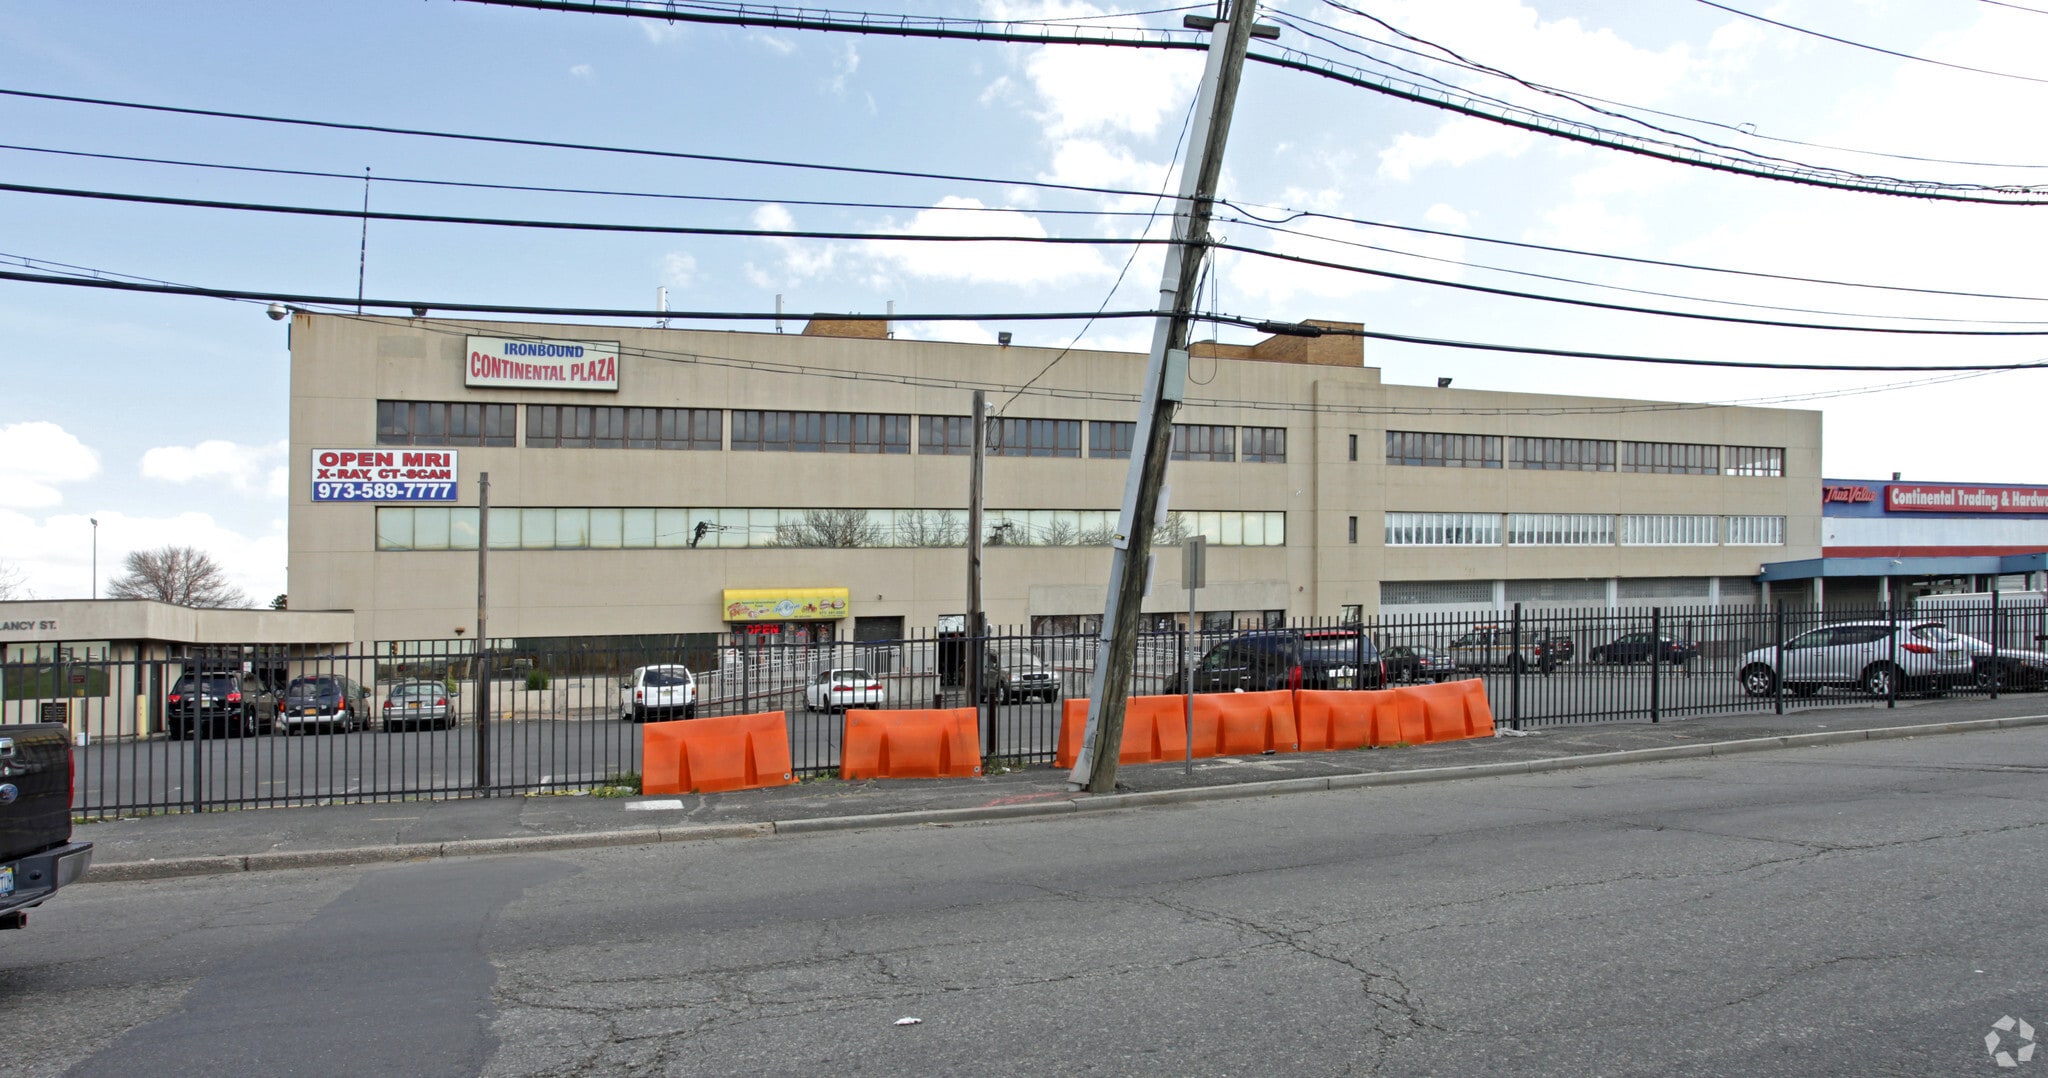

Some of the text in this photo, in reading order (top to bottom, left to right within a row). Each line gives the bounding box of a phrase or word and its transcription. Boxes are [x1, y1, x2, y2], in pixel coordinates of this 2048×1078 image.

[504, 343, 584, 358] IRONBOUND
[471, 351, 616, 382] CONTINENTAL PLAZA
[319, 452, 450, 467] OPEN MRI
[317, 468, 451, 481] X-RAY, CT-SCAN
[318, 483, 452, 498] 973-589-7777
[1823, 486, 1876, 503] True Value
[1892, 488, 1955, 505] Continental
[1957, 489, 1998, 511] Trading
[2001, 490, 2010, 507] &
[0, 620, 57, 631] ANCY ST.
[746, 624, 779, 635] OPEN
